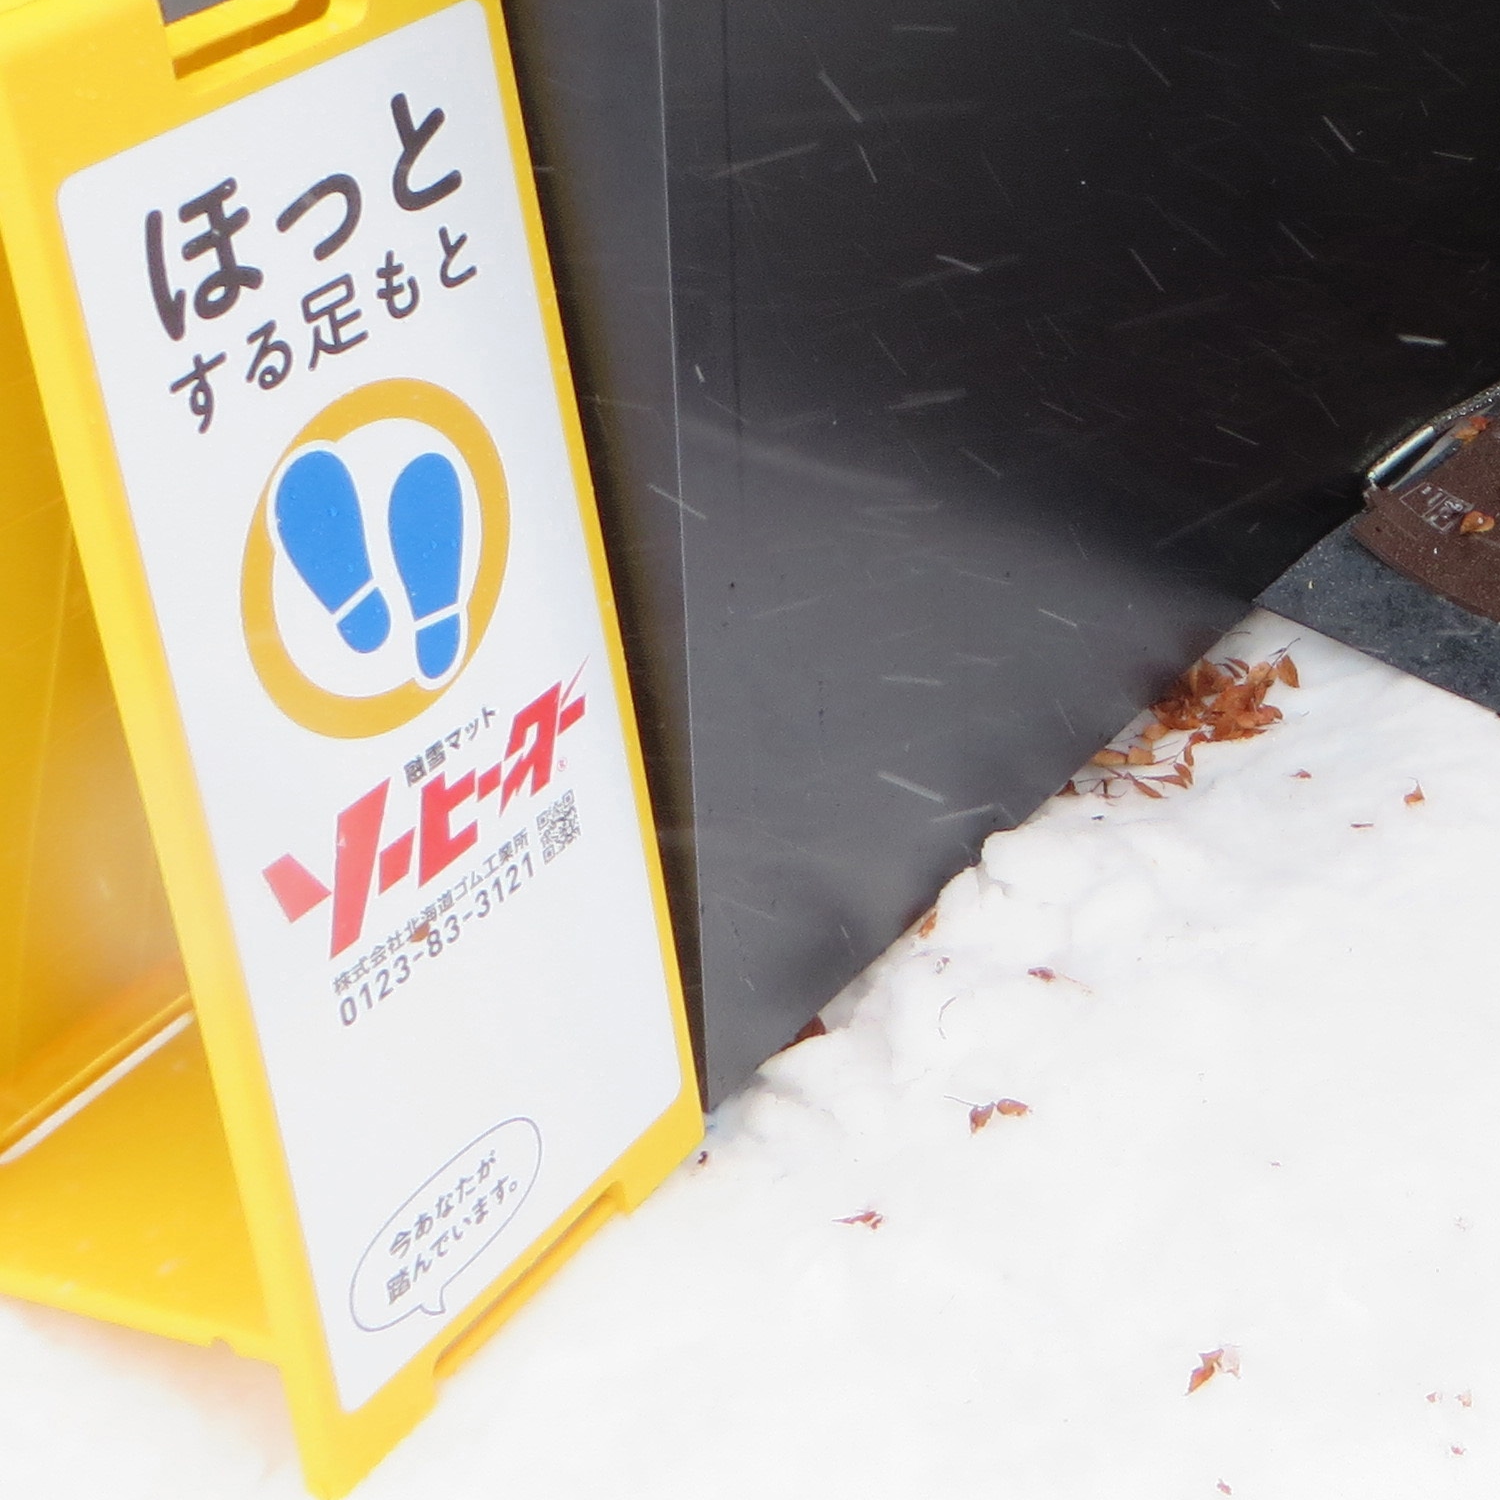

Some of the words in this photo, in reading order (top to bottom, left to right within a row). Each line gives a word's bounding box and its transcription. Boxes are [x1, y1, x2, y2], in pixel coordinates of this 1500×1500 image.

[145, 92, 463, 341] ほっと
[169, 225, 478, 434] する足もと
[261, 668, 587, 961] ソーヒーター
[403, 706, 497, 787] 融雪マット
[333, 827, 529, 996] 株式会社北海道ゴム工業所
[338, 850, 535, 1028] 0123-83-3121
[386, 1175, 518, 1305] 踏んでいます。
[390, 1149, 497, 1259] 今あなたが
